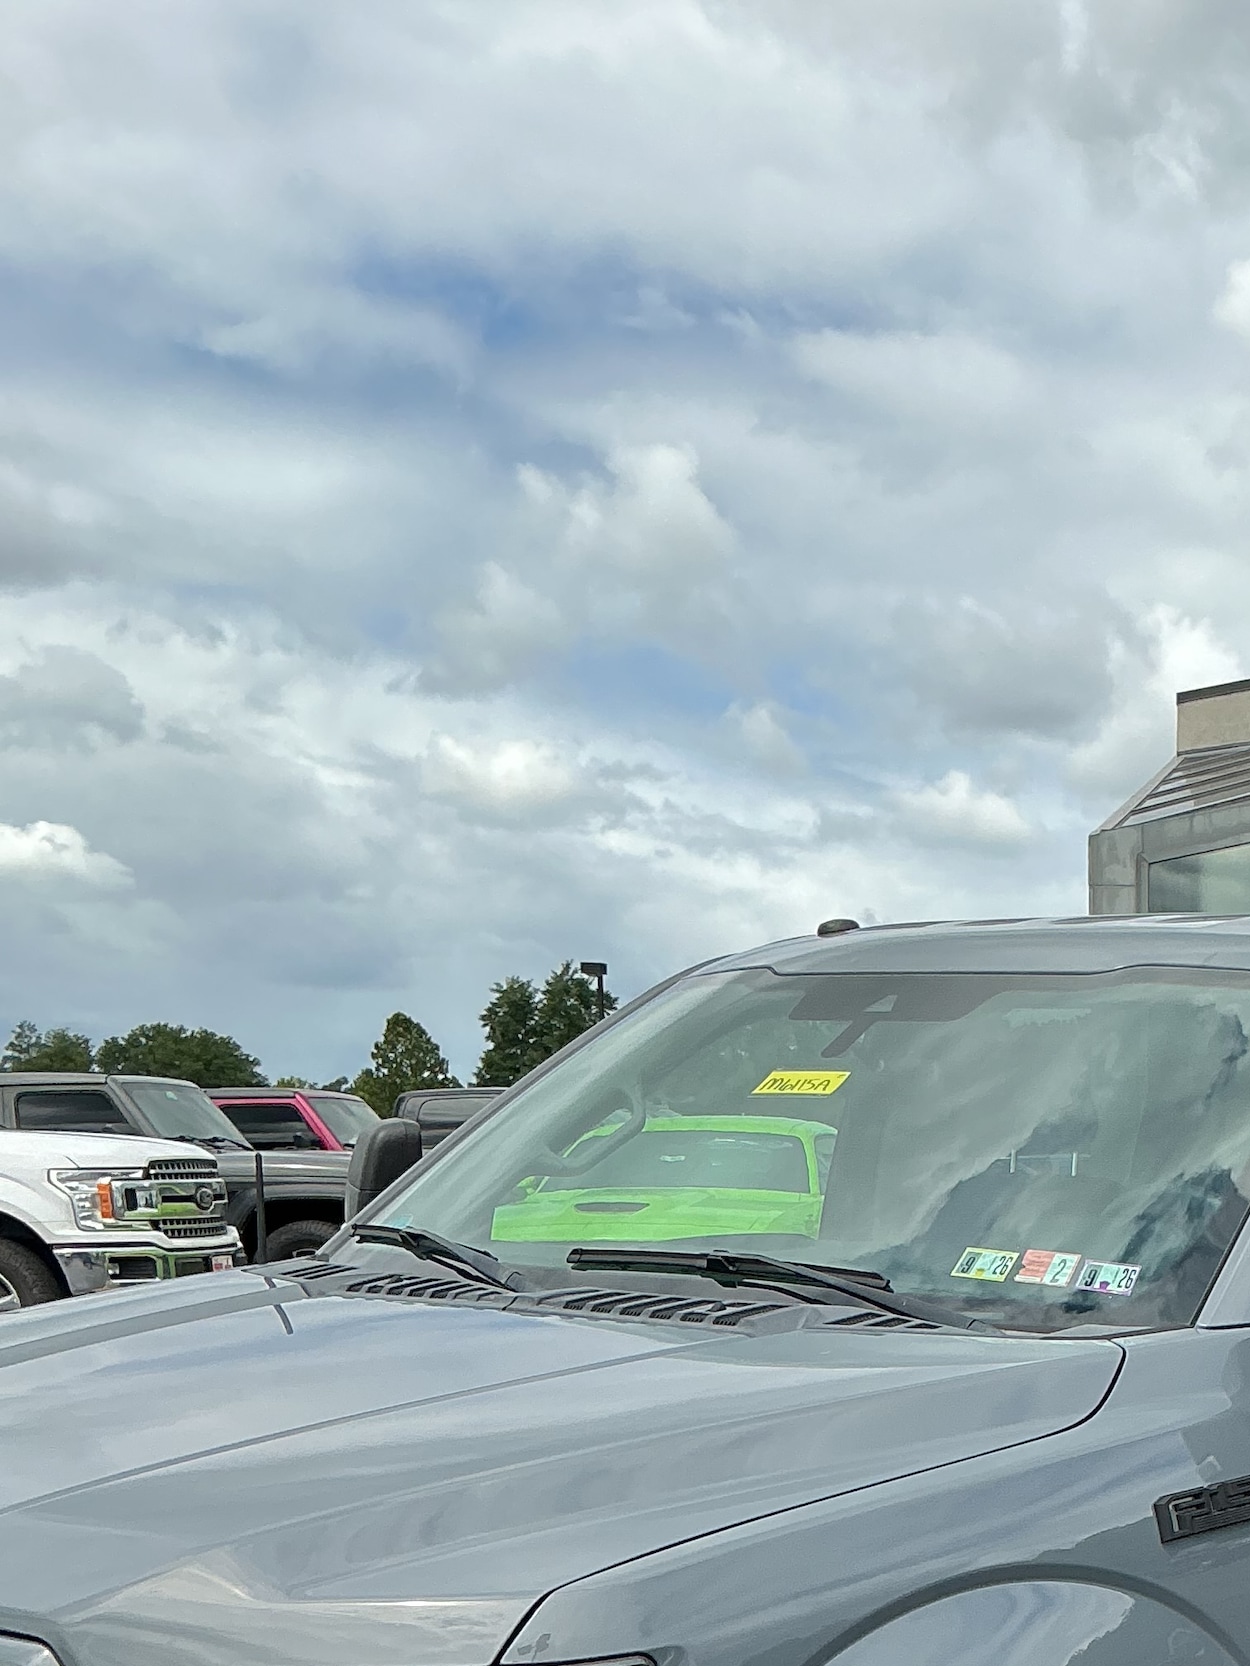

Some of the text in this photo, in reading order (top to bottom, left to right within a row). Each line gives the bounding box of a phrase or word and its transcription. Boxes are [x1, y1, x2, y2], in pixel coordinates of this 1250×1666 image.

[961, 1256, 976, 1273] 9
[992, 1255, 1013, 1276] 26
[1050, 1258, 1067, 1283] 2
[1084, 1268, 1137, 1289] 9 26
